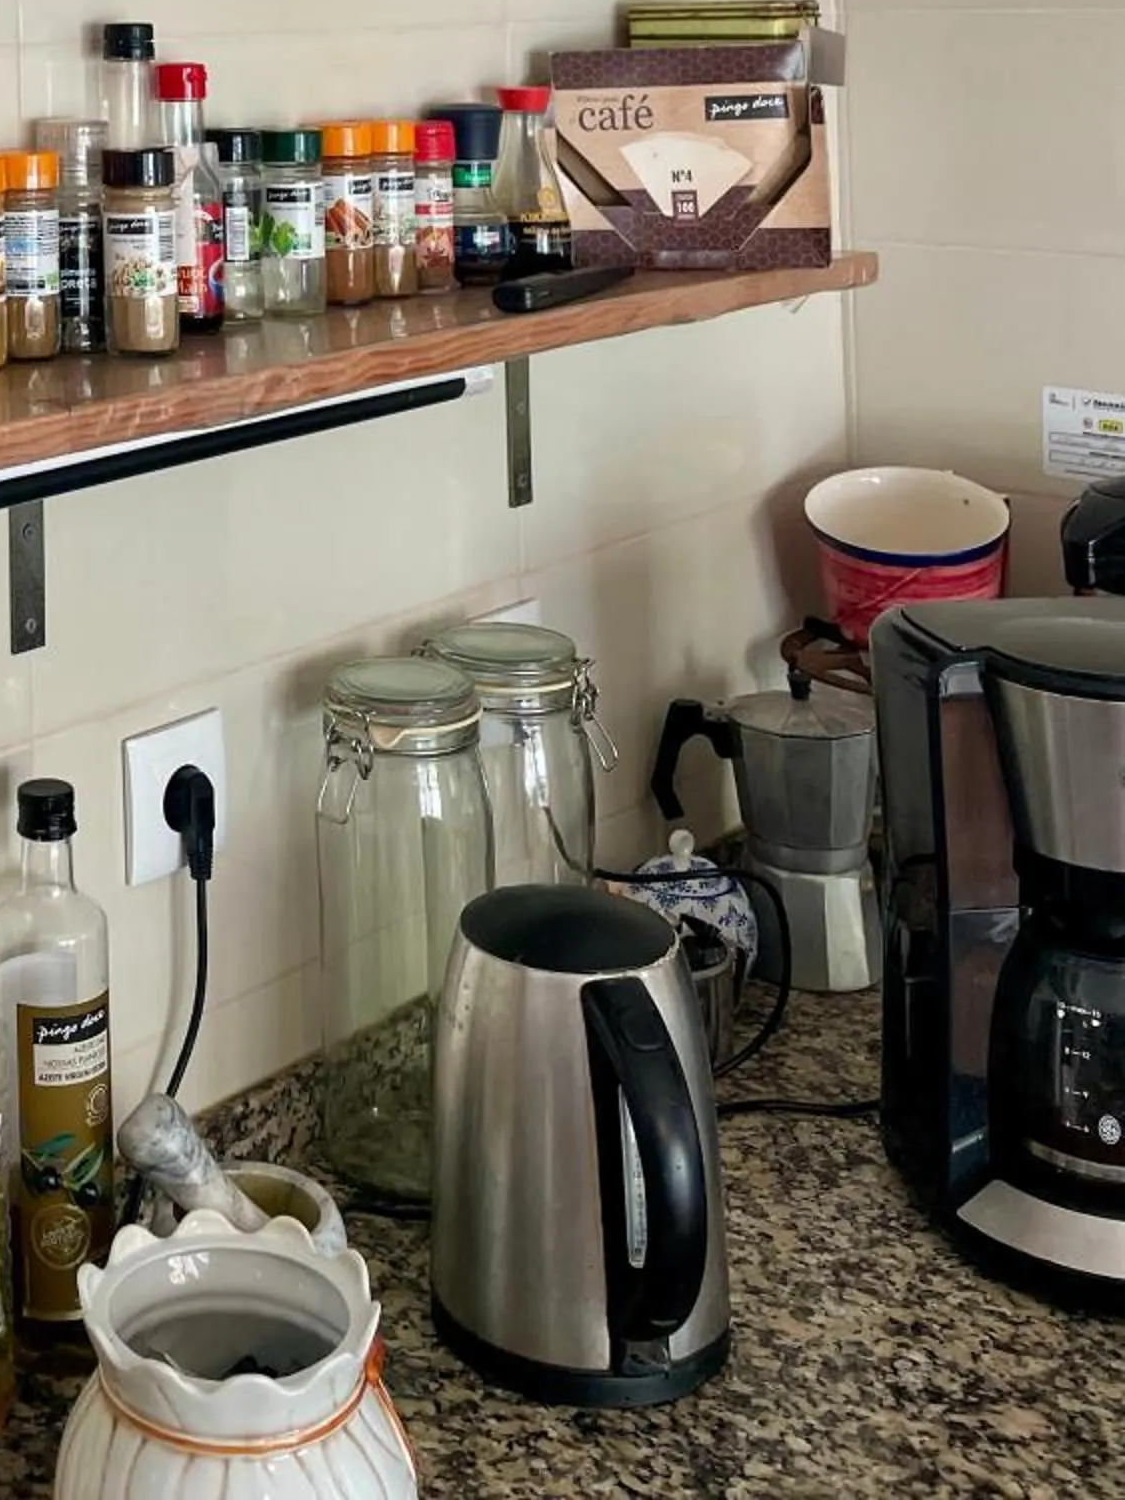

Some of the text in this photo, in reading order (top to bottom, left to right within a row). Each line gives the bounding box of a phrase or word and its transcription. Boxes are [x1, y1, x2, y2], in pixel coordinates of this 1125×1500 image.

[578, 94, 654, 132] café
[709, 96, 785, 121] pingo doce
[37, 1008, 105, 1044] pingo doce
